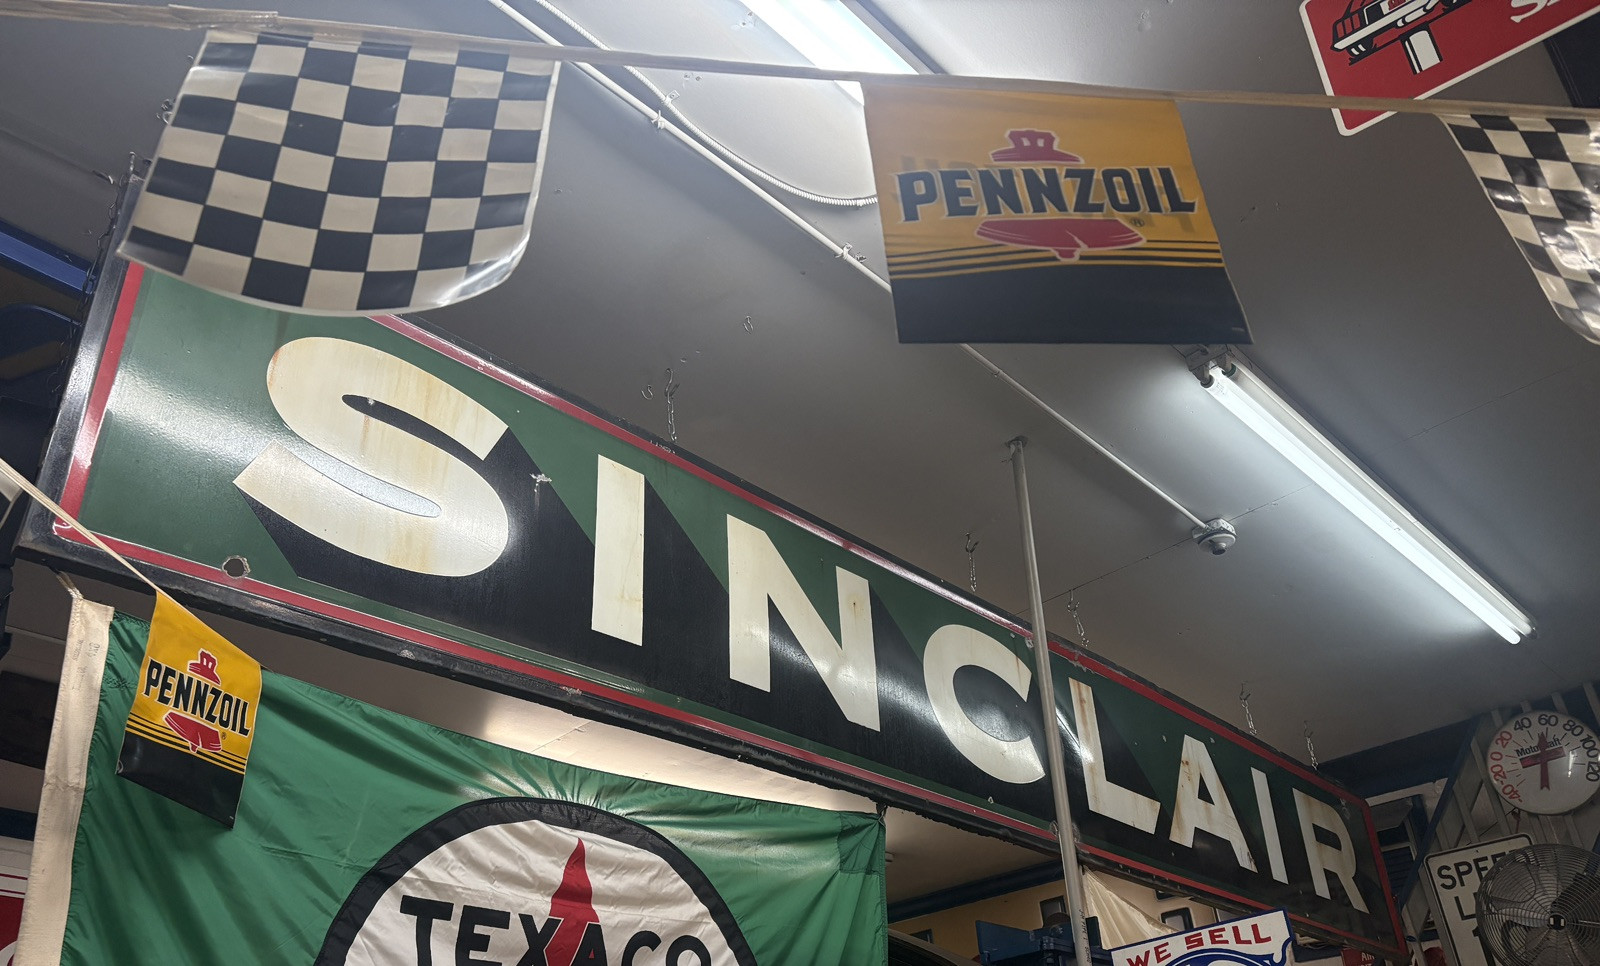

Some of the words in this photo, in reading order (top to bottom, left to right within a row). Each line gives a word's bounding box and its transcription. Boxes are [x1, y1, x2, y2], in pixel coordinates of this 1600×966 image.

[895, 166, 1198, 222] PENNZOIL
[234, 337, 1370, 913] SINCLAIR
[144, 658, 251, 736] PENNZOIL
[1514, 717, 1532, 731] 40
[1538, 714, 1559, 727] 60
[1563, 720, 1585, 737] 80
[1495, 730, 1513, 749] 20
[1515, 736, 1561, 757] Motoaft
[1580, 734, 1600, 758] 100
[1490, 751, 1504, 762] 0
[1586, 761, 1600, 782] 120
[1437, 849, 1516, 890] SPE
[1126, 942, 1172, 966] WE
[1184, 923, 1272, 950] SELL
